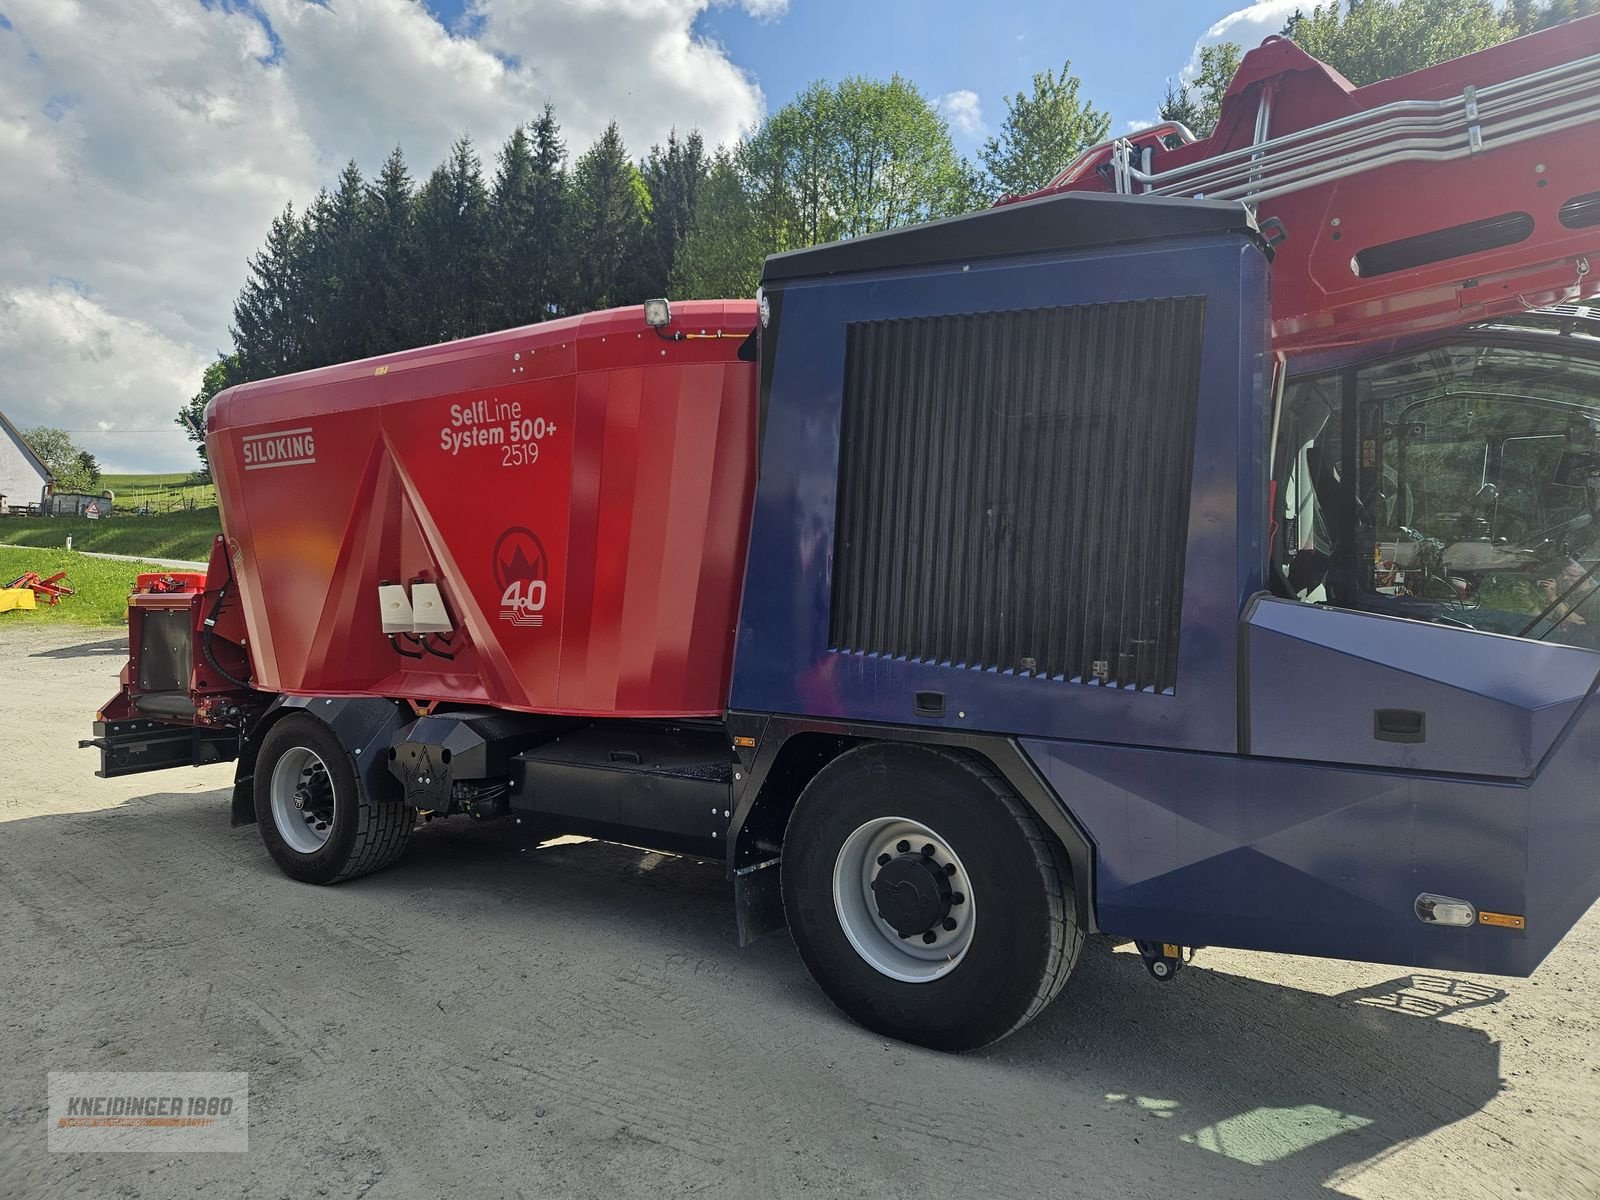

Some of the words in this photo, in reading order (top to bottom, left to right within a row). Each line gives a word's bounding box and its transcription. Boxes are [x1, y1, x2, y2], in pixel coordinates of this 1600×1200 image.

[450, 398, 522, 427] SelfLine
[243, 434, 315, 463] SILOKING
[440, 426, 505, 456] System
[510, 417, 557, 442] 500+
[501, 442, 539, 467] 2519
[501, 580, 547, 611] 4.0
